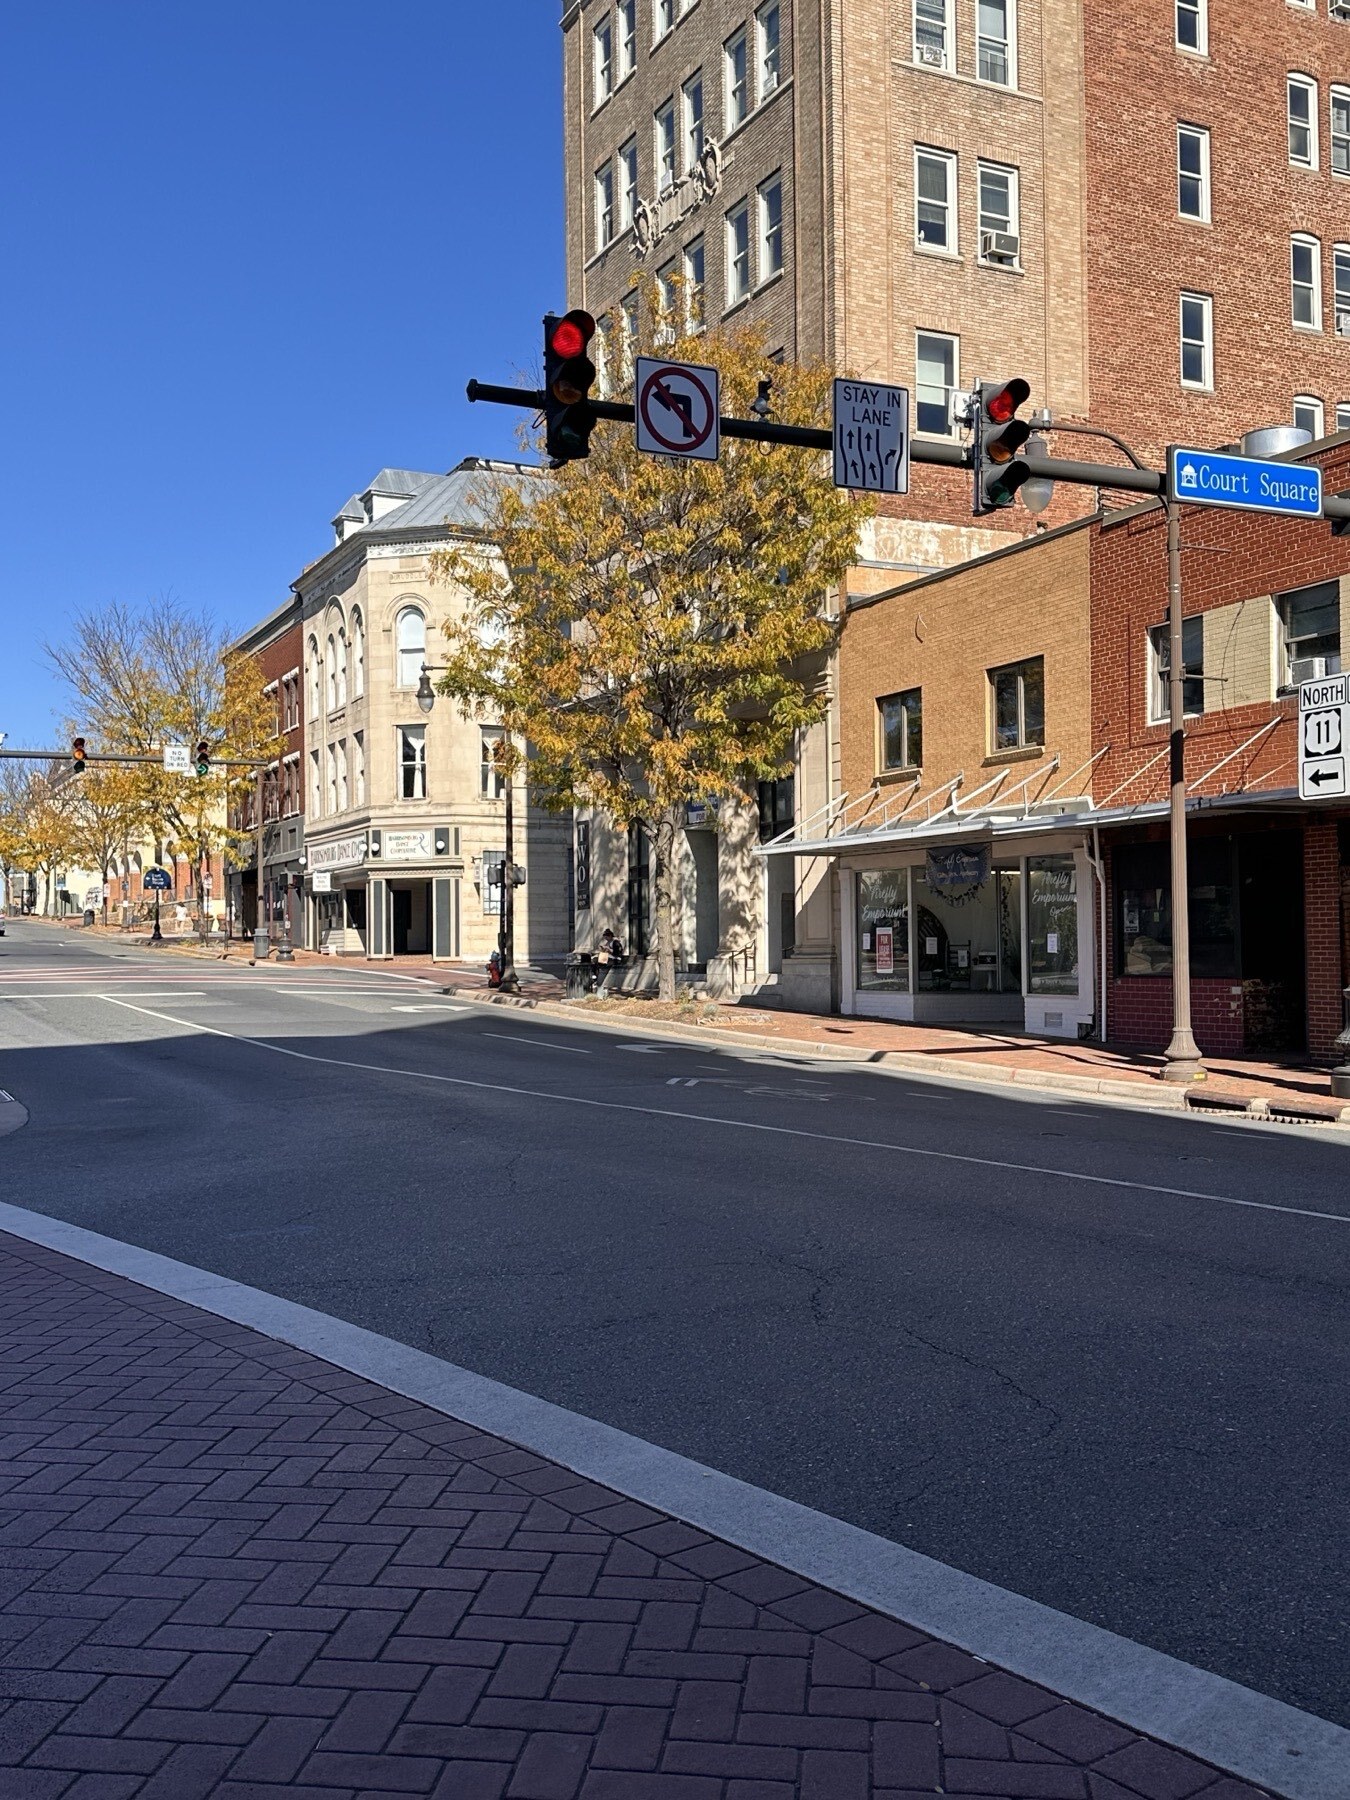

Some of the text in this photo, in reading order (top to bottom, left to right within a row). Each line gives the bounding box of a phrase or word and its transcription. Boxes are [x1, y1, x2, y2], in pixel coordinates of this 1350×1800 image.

[843, 386, 901, 408] STAY IN
[852, 406, 891, 427] LANE
[1199, 465, 1319, 503] Court Square
[1302, 683, 1344, 707] NORTH
[1316, 719, 1330, 744] 11
[1032, 889, 1077, 907] Emporium
[861, 904, 905, 924] Emporium
